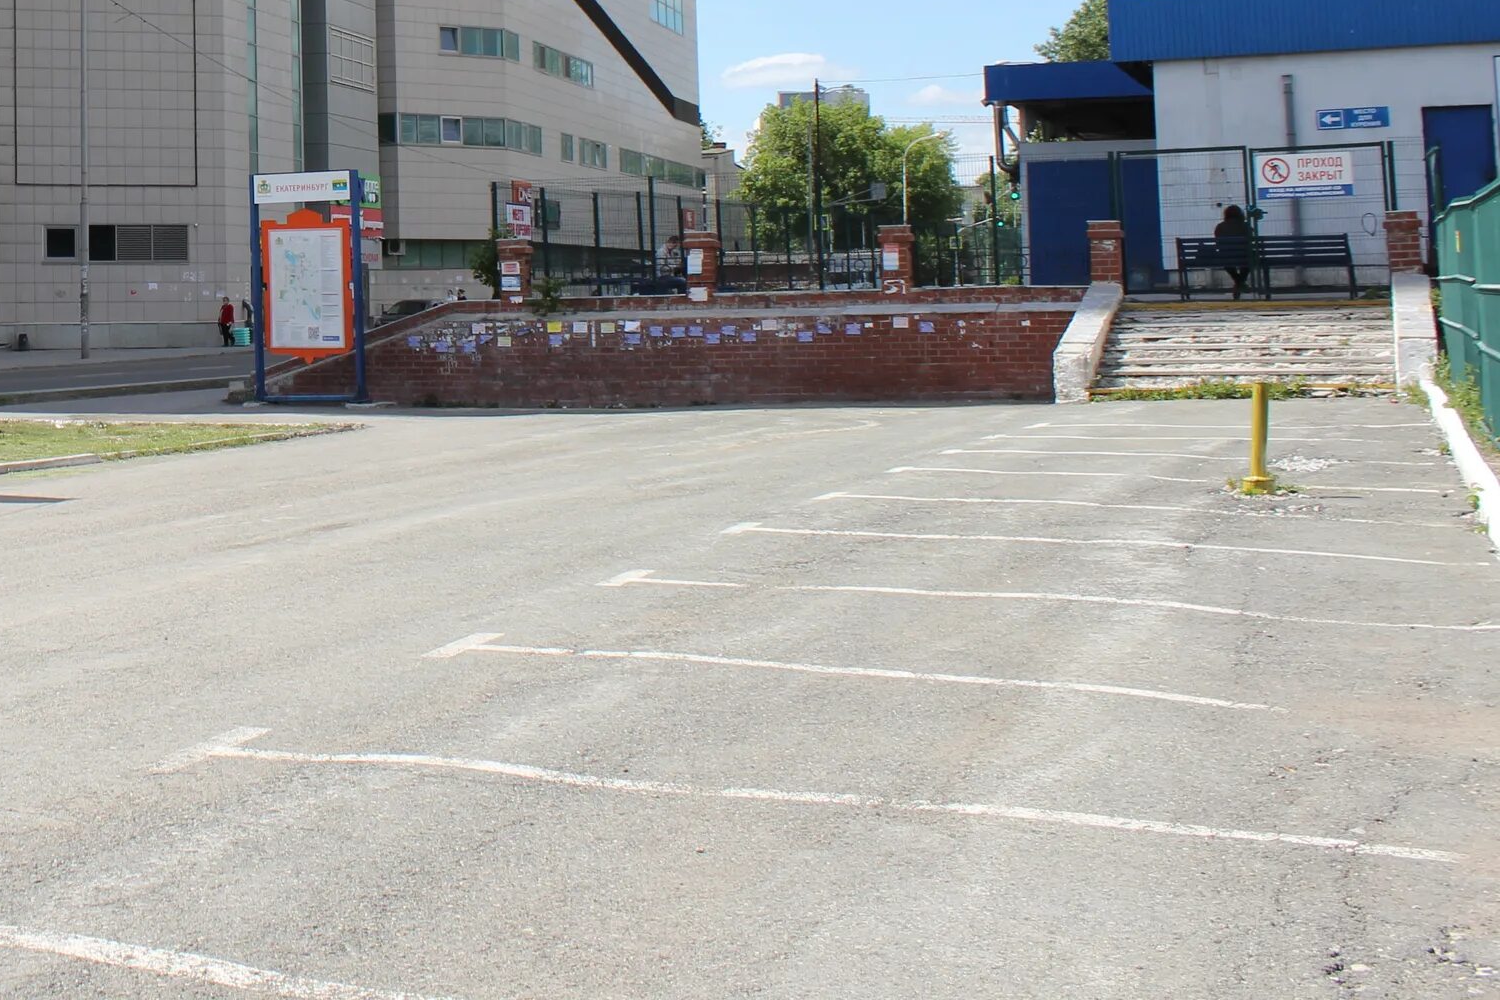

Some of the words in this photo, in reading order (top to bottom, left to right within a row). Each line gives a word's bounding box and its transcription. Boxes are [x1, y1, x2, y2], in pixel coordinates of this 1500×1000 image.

[1297, 156, 1343, 169] ПРОХОД
[1297, 170, 1343, 182] ЗАКРЫТ
[275, 183, 329, 193] ЕКАТЕРИНБУРГ
